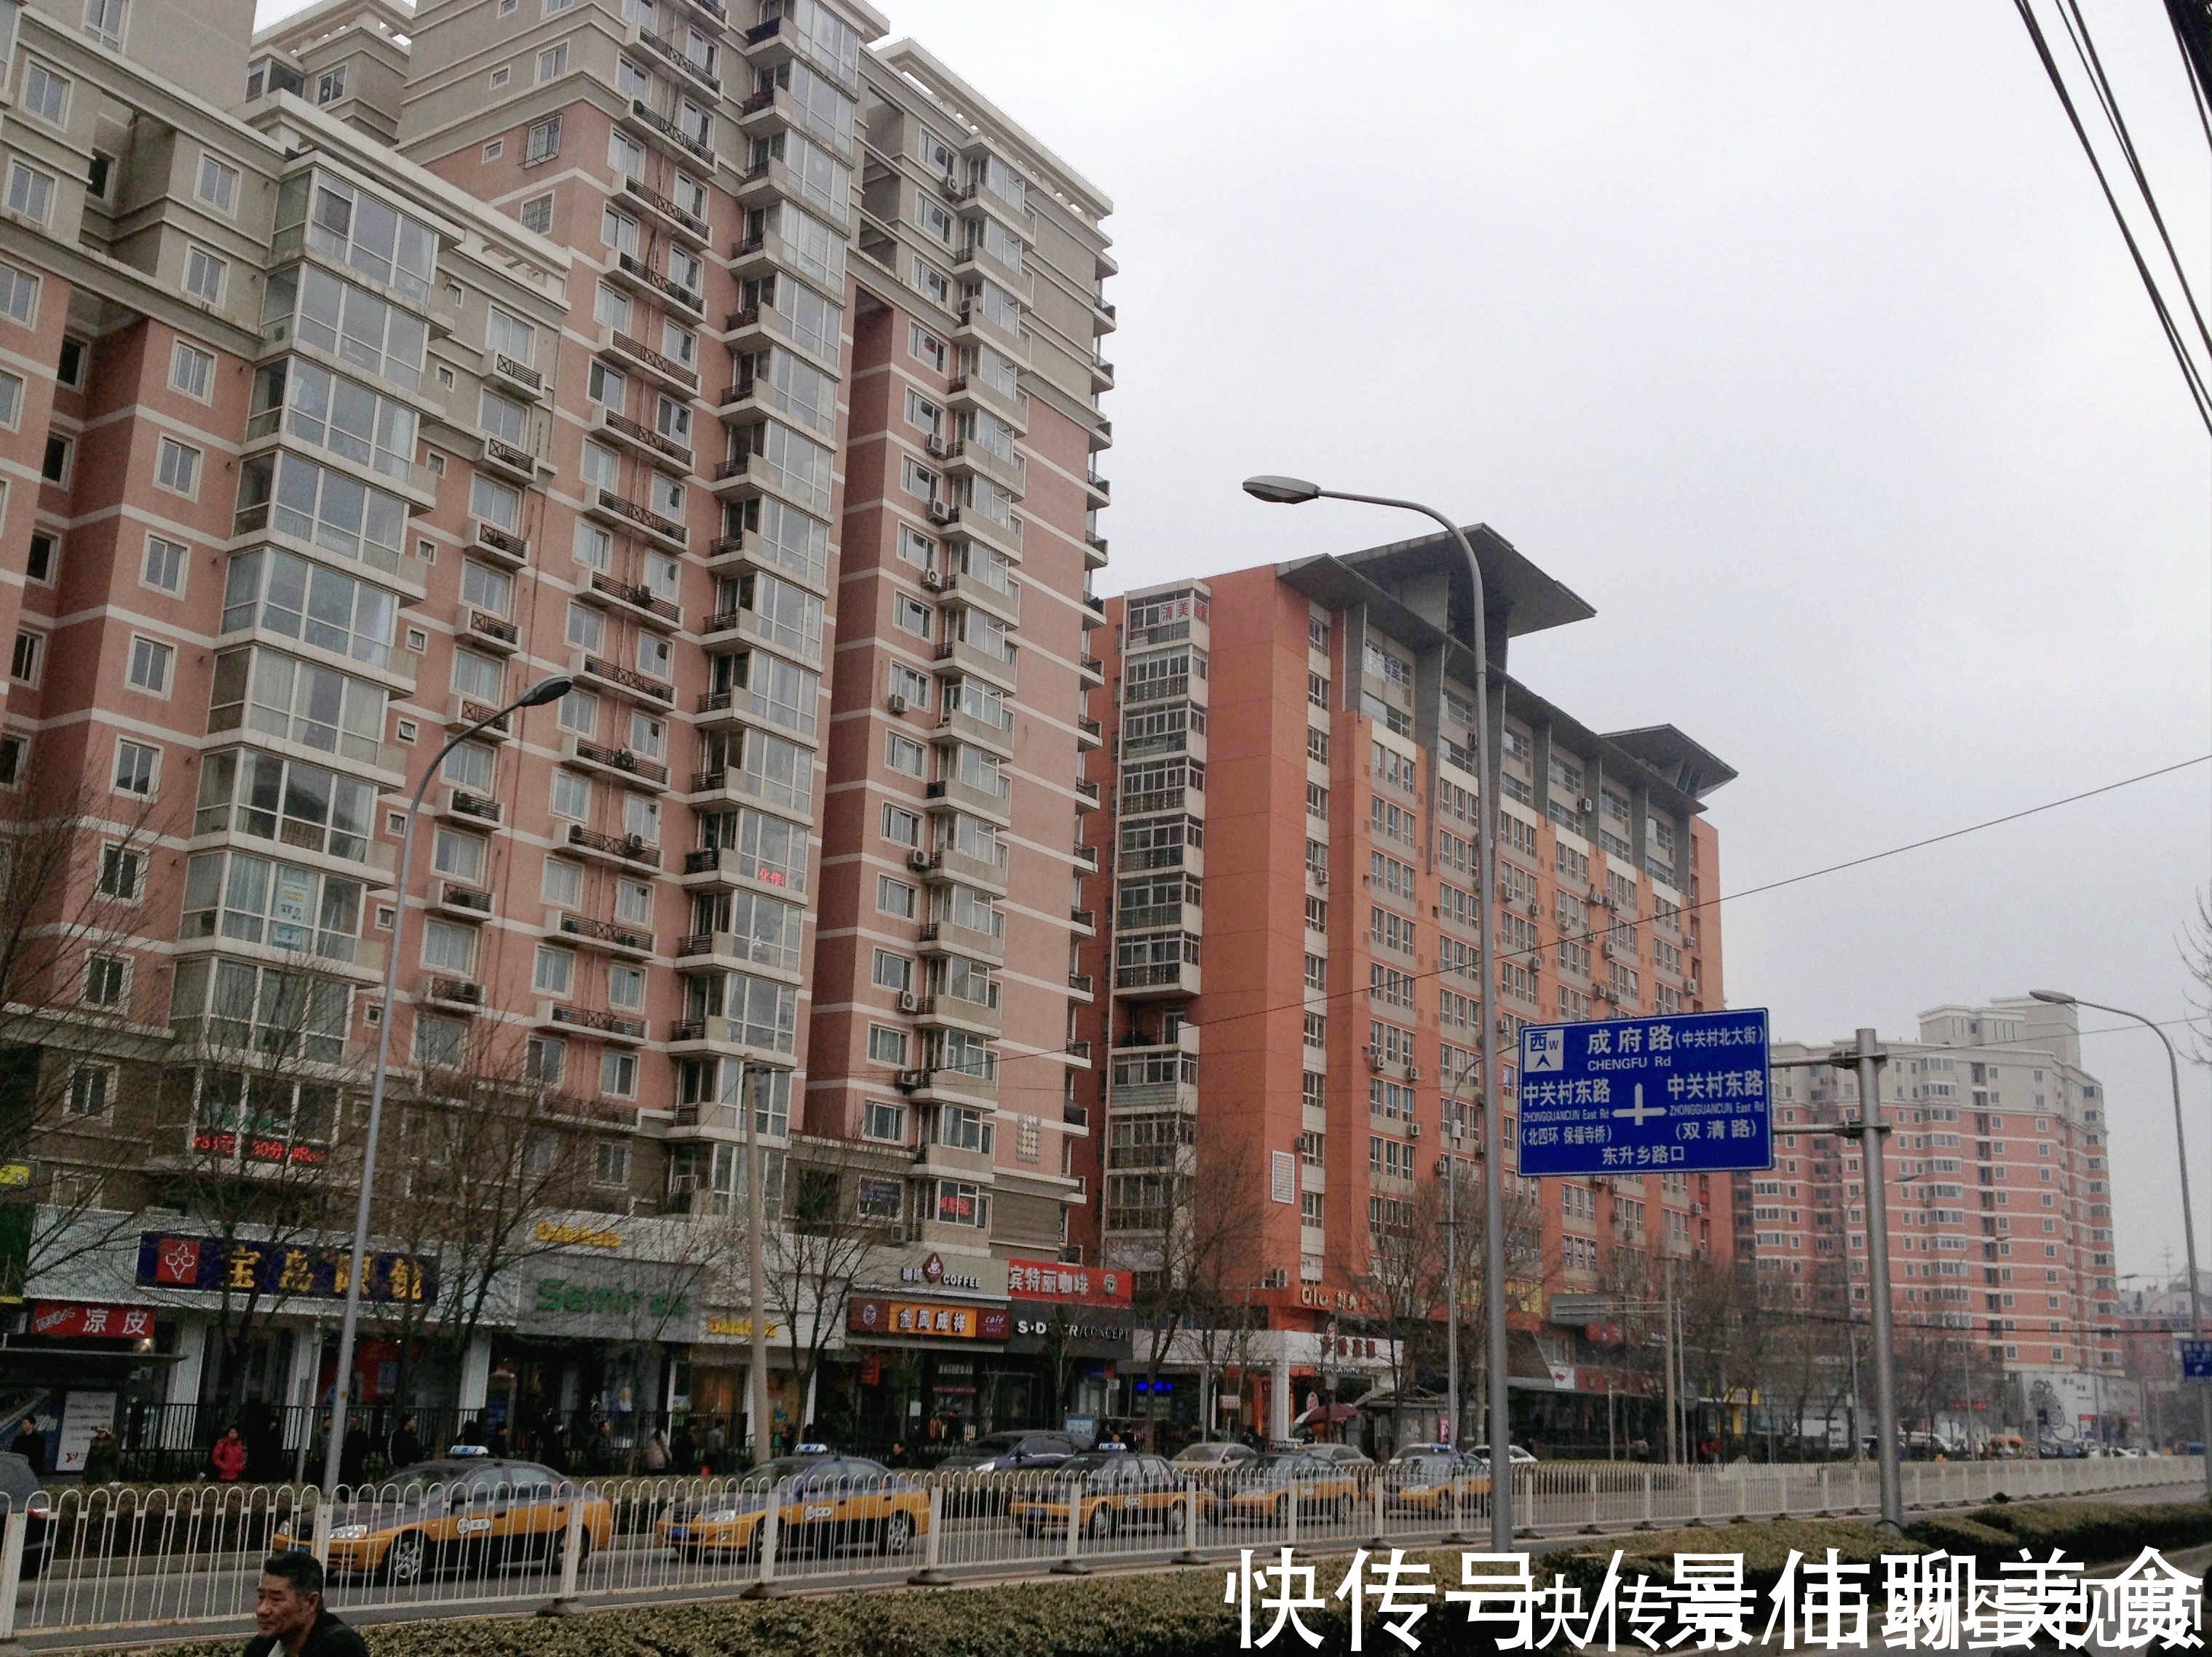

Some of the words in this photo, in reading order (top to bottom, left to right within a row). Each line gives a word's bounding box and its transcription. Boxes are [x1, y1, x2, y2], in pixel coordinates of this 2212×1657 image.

[1531, 1033, 1547, 1052] 西
[1548, 1040, 1559, 1051] W
[1587, 1025, 1674, 1054] 成府路
[1676, 1025, 1765, 1049] (中关村北大街)
[1587, 1057, 1647, 1071] CHENGFU
[1655, 1056, 1672, 1068] Rd
[1523, 1078, 1611, 1106] 中关村东路
[1668, 1068, 1764, 1100] 中关村东路
[1523, 1110, 1580, 1123] ZHONGGUANCUN
[1582, 1108, 1597, 1120] East
[1670, 1102, 1732, 1116] ZHONGGUANCUN
[1736, 1101, 1751, 1113] East
[1602, 1146, 1684, 1166] 东升乡路口
[943, 1273, 982, 1289] COFFEE
[82, 1308, 148, 1335] 凉皮
